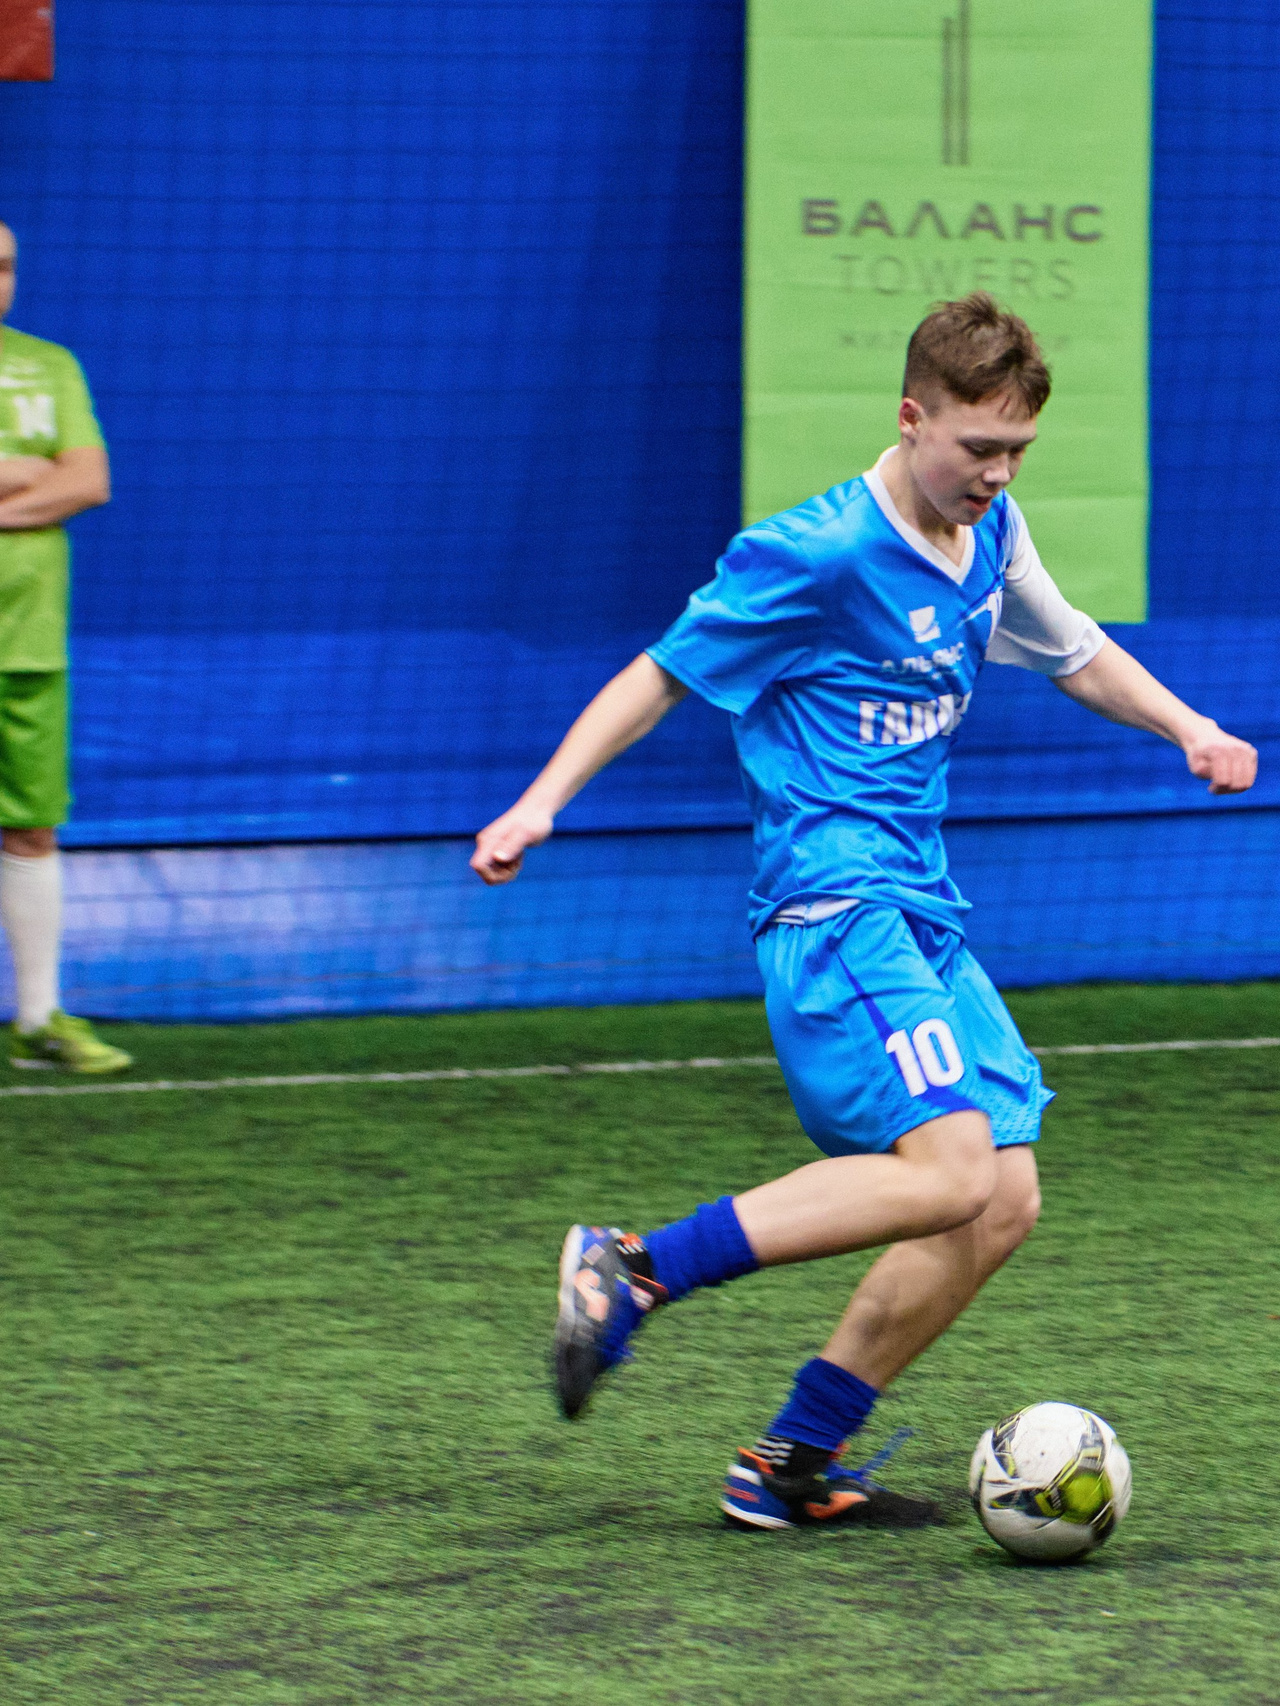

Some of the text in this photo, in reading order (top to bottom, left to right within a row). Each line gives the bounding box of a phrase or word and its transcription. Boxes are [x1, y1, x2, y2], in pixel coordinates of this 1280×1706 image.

[802, 199, 1103, 243] БАЛАНС
[833, 253, 1077, 300] TOWERS
[884, 1017, 965, 1098] 10
